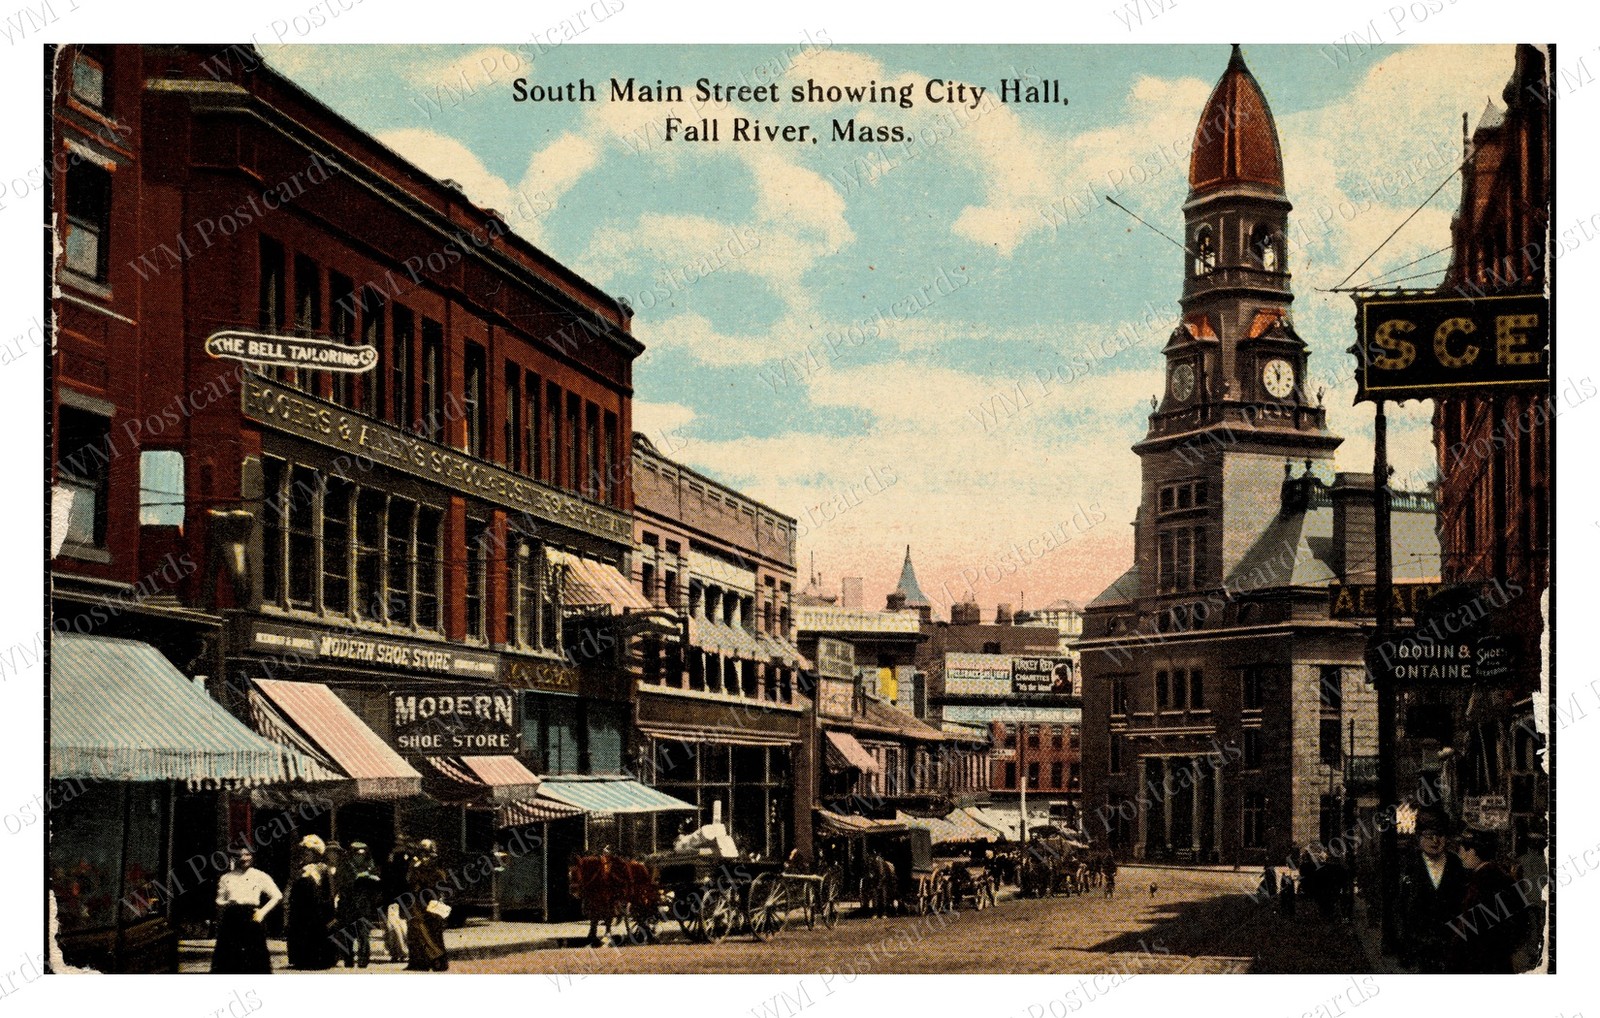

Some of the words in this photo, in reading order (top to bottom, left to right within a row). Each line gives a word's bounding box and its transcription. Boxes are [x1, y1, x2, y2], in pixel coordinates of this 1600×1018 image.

[210, 337, 245, 354] THE
[248, 340, 286, 358] BELL
[288, 345, 359, 366] TAILORING
[1375, 314, 1541, 370] SCE
[338, 416, 352, 441] &
[320, 636, 375, 660] MODERN
[376, 644, 410, 666] SHOE
[413, 649, 451, 671] STORE
[1458, 644, 1471, 658] &
[1013, 659, 1038, 672] TURKEY
[1039, 658, 1053, 672] RED
[395, 696, 512, 727] MODERN
[398, 735, 442, 748] SHOE
[453, 734, 510, 748] STORE
